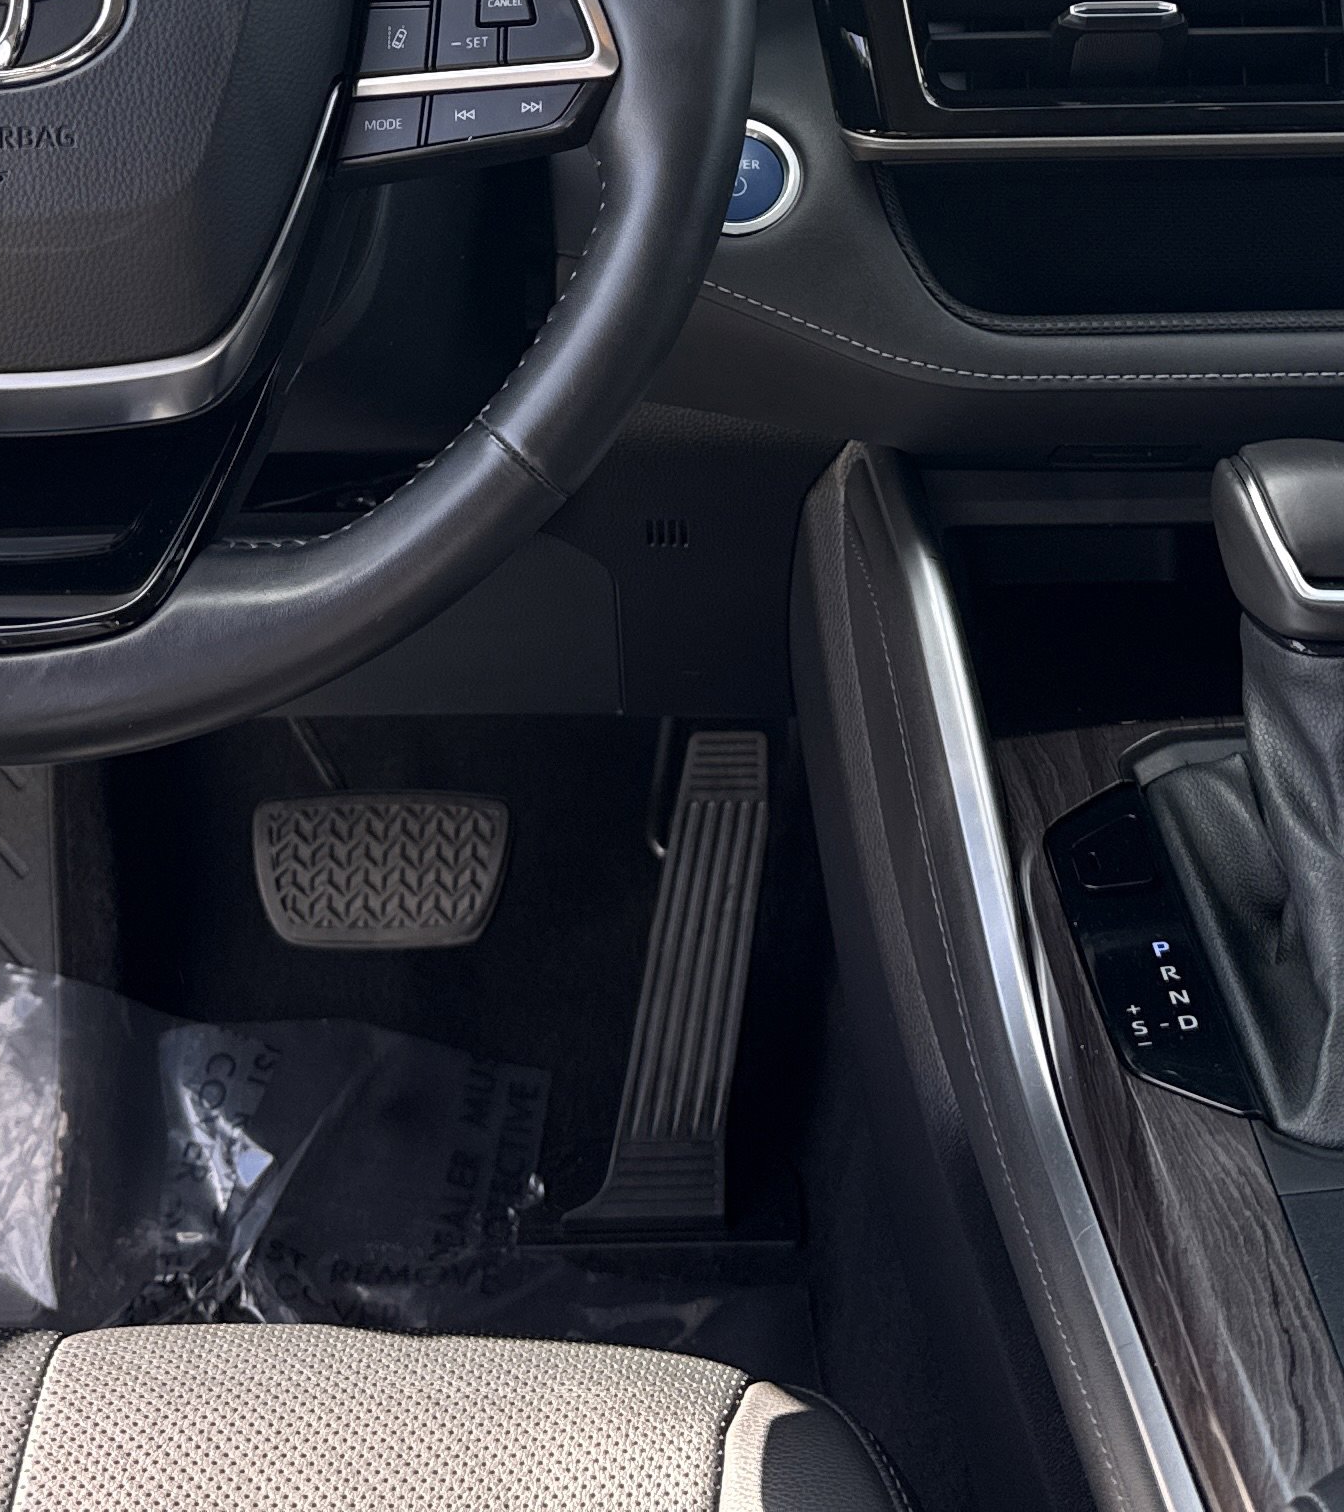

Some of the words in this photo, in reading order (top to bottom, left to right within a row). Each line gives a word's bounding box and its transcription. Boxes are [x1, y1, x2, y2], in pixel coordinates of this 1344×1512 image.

[465, 36, 489, 48] SET
[364, 117, 403, 131] MODE
[1152, 941, 1170, 958] P
[1159, 965, 1182, 982] R
[1168, 989, 1191, 1005] N
[1131, 1020, 1149, 1036] S
[1177, 1015, 1199, 1030] D
